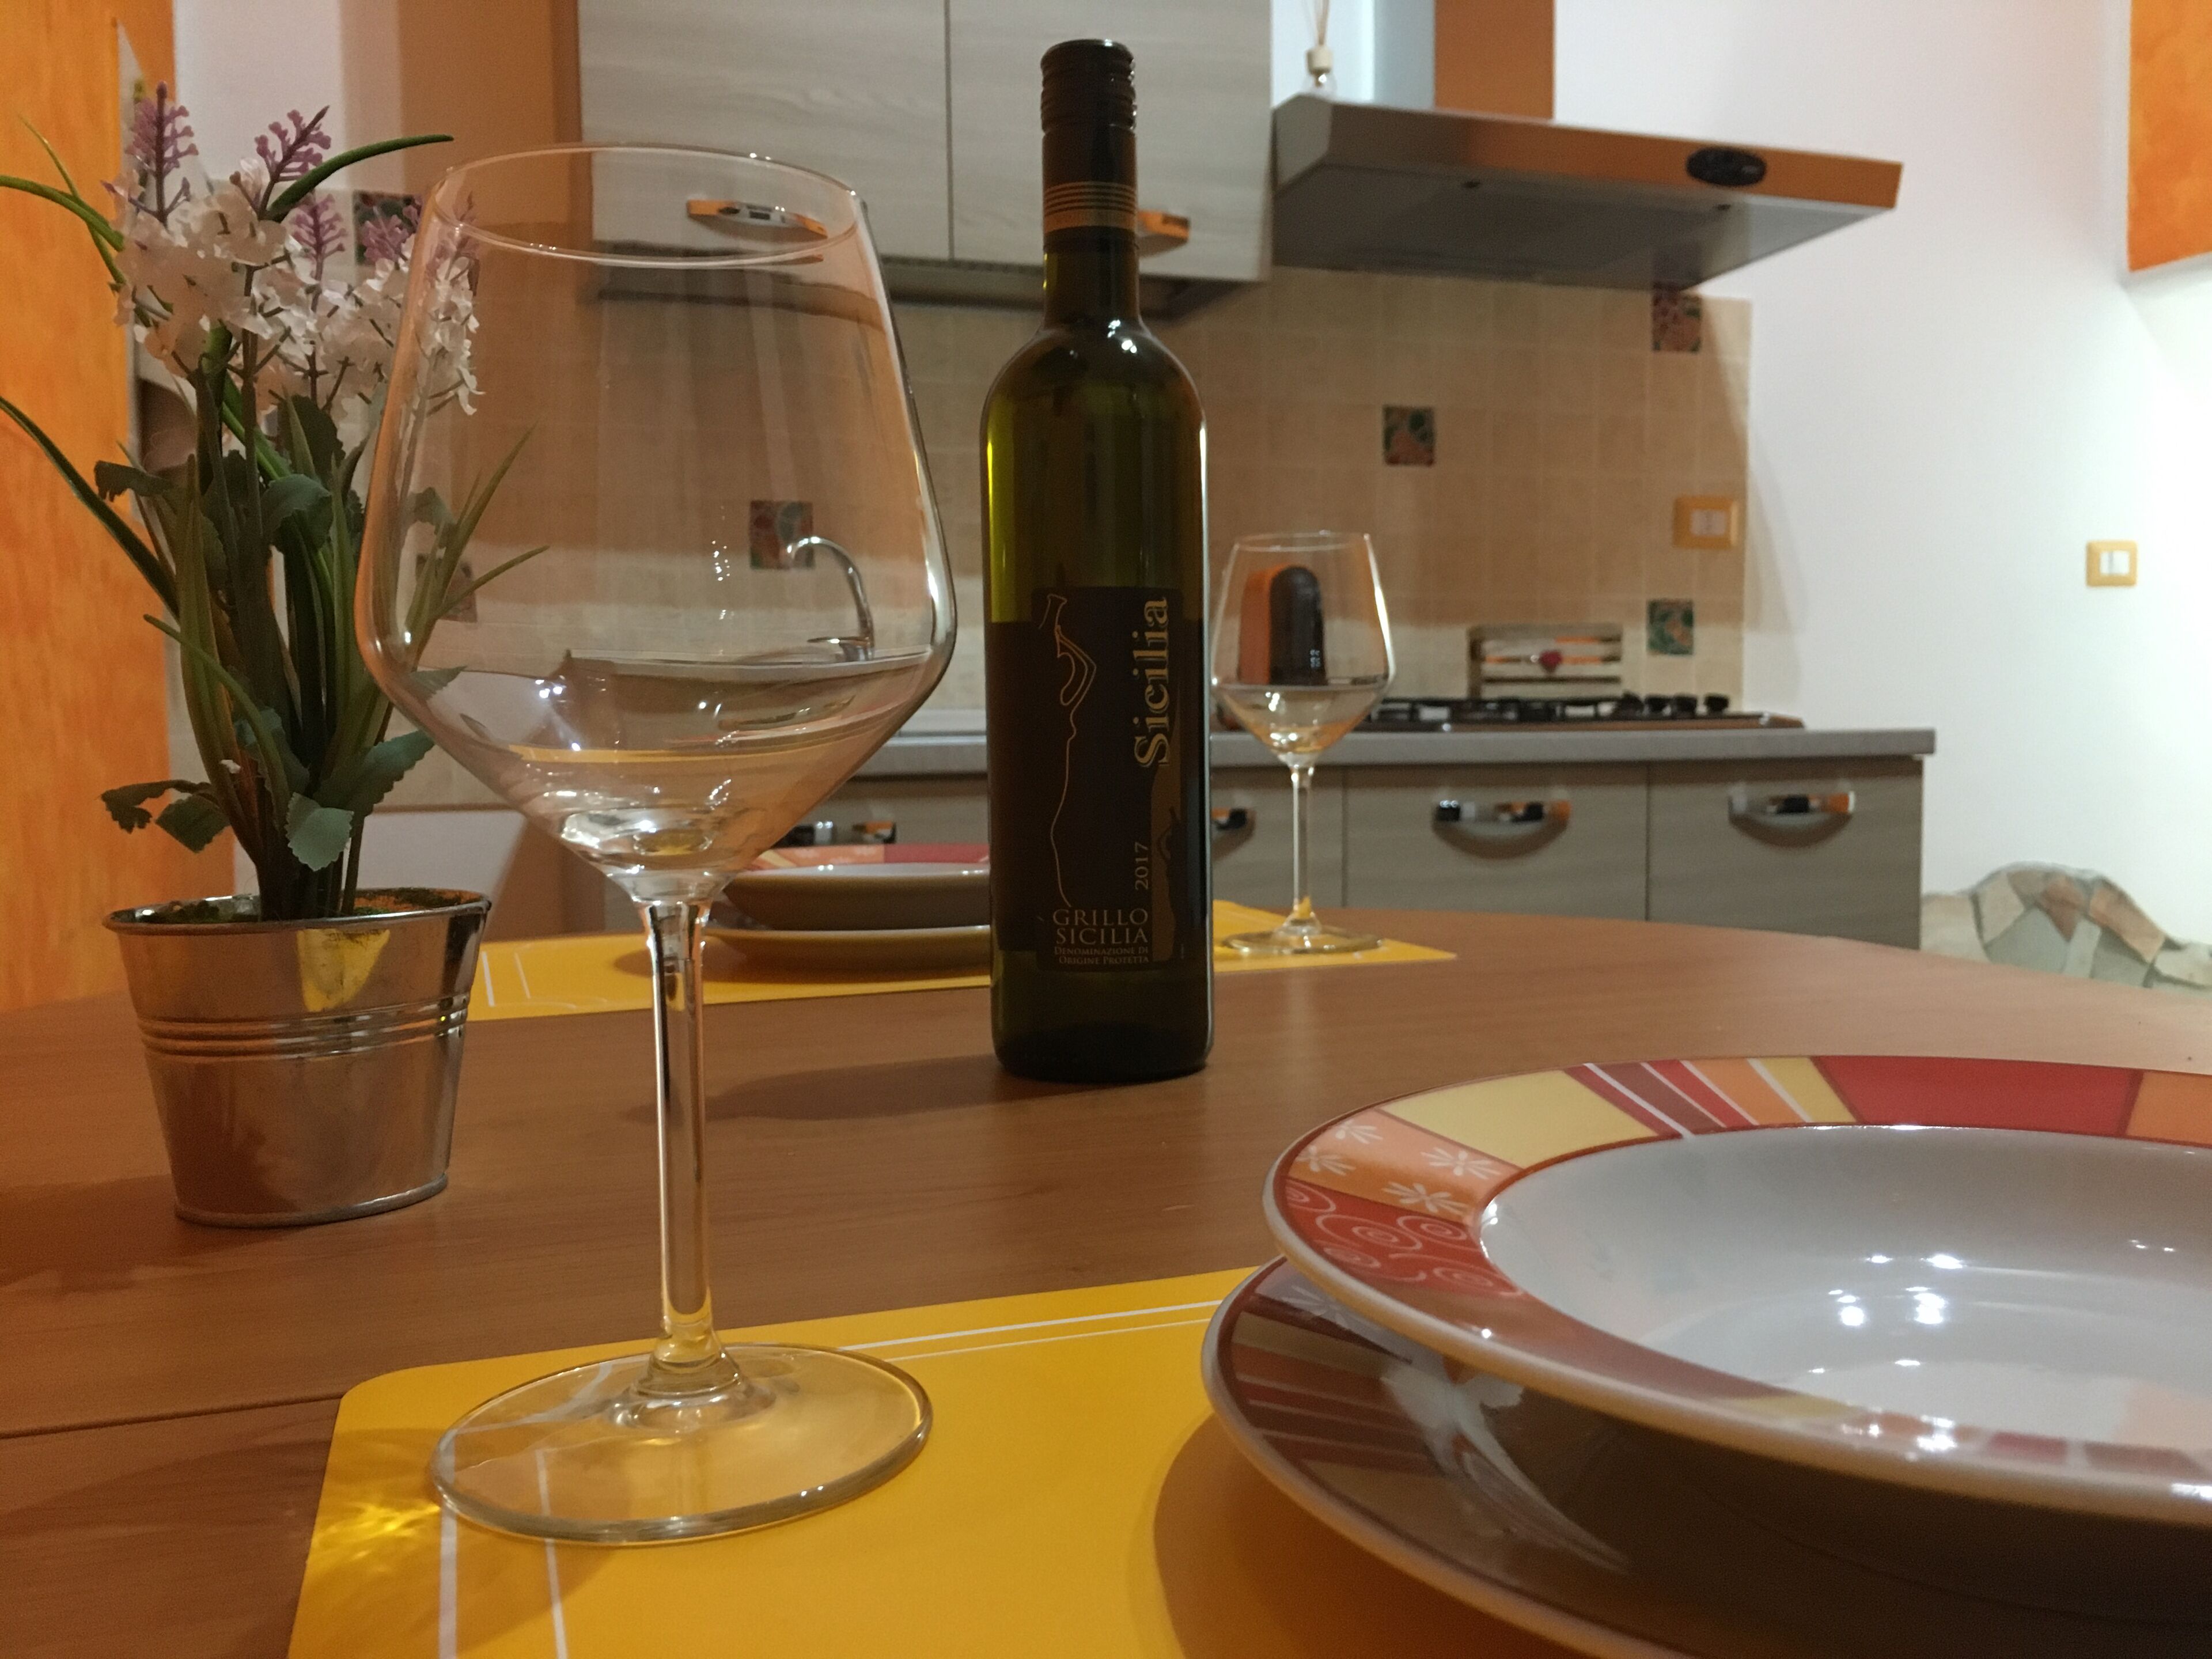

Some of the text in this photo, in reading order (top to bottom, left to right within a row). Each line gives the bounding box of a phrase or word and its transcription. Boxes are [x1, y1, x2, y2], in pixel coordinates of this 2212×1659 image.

[1132, 596, 1170, 768] Sicilia
[1135, 842, 1149, 890] 2017
[1052, 908, 1149, 926] GRILLO
[1056, 927, 1148, 945] SICILIA
